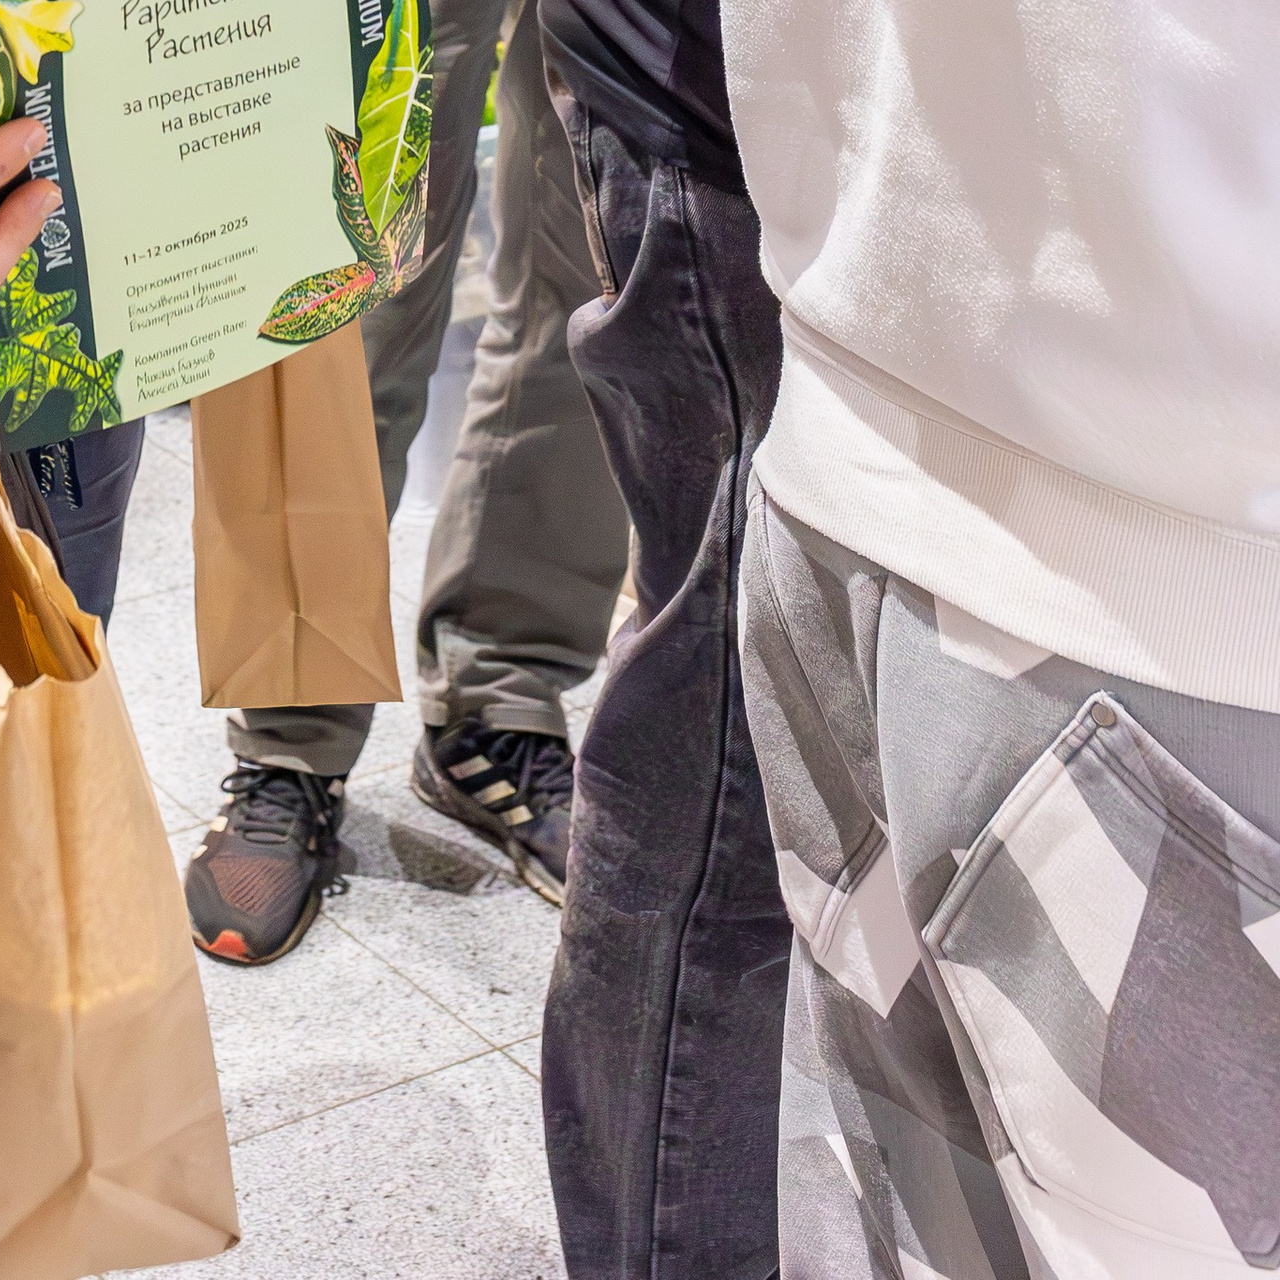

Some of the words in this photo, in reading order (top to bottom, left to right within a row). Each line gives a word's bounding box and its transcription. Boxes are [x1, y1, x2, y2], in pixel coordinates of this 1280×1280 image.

[145, 14, 272, 64] Растения
[123, 100, 143, 116] за
[148, 56, 301, 110] представленные
[161, 117, 183, 134] на
[189, 92, 272, 126] выставке
[179, 121, 261, 161] растения
[165, 228, 216, 254] октября
[220, 216, 248, 235] 2025
[126, 266, 198, 298] Оргкомитет
[134, 341, 188, 367] Компания
[190, 329, 221, 348] Green
[137, 379, 179, 403] Алексей
